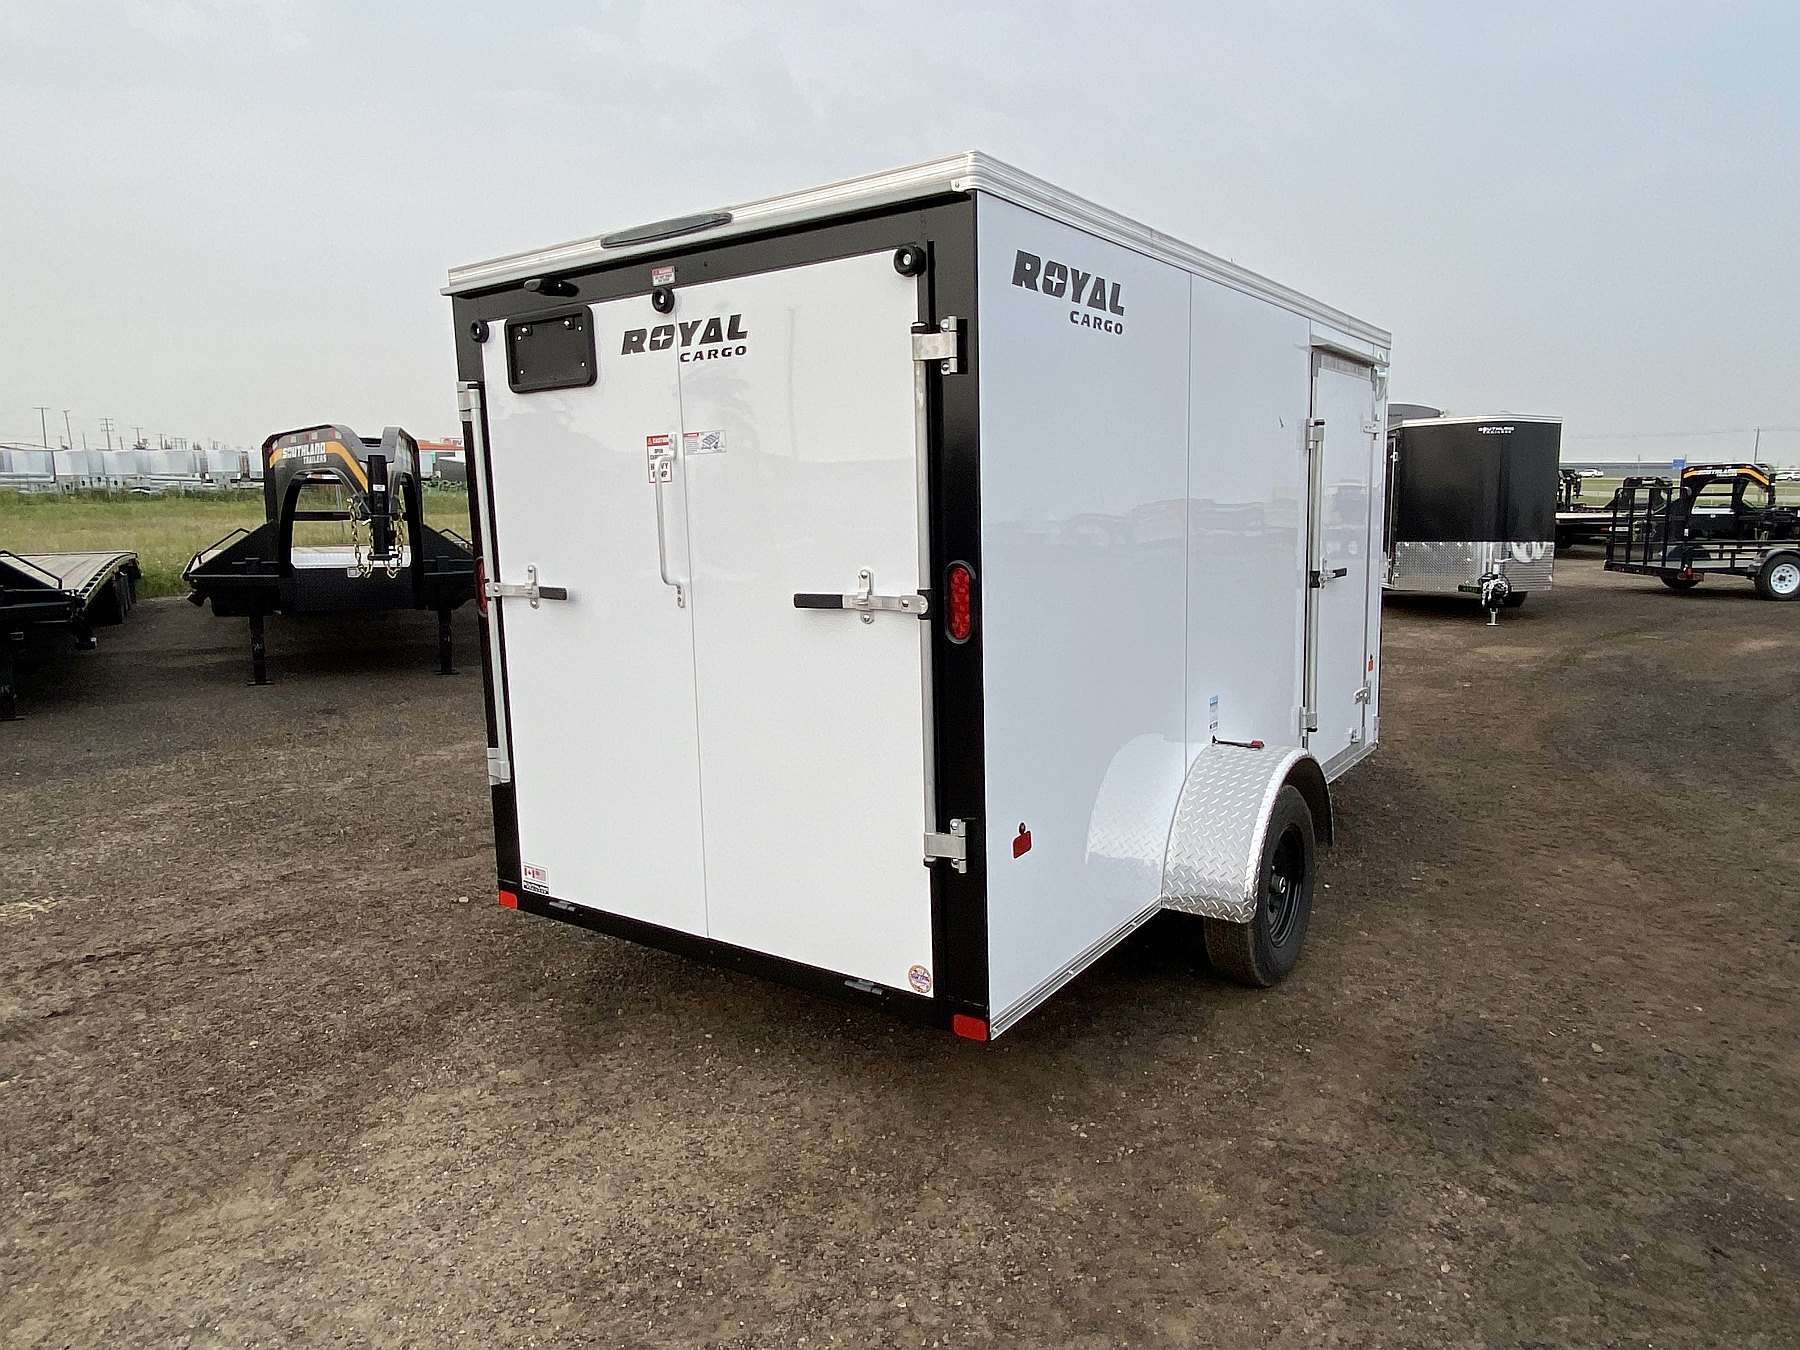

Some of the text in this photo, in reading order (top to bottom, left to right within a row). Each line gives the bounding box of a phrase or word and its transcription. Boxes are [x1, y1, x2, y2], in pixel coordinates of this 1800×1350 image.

[1012, 249, 1125, 317] ROYAL
[1069, 310, 1124, 336] CARGO
[621, 314, 748, 355] ROYAL
[680, 345, 748, 363] CARGO
[282, 442, 326, 459] SOUTHLAND
[303, 454, 327, 465] TRAILERS
